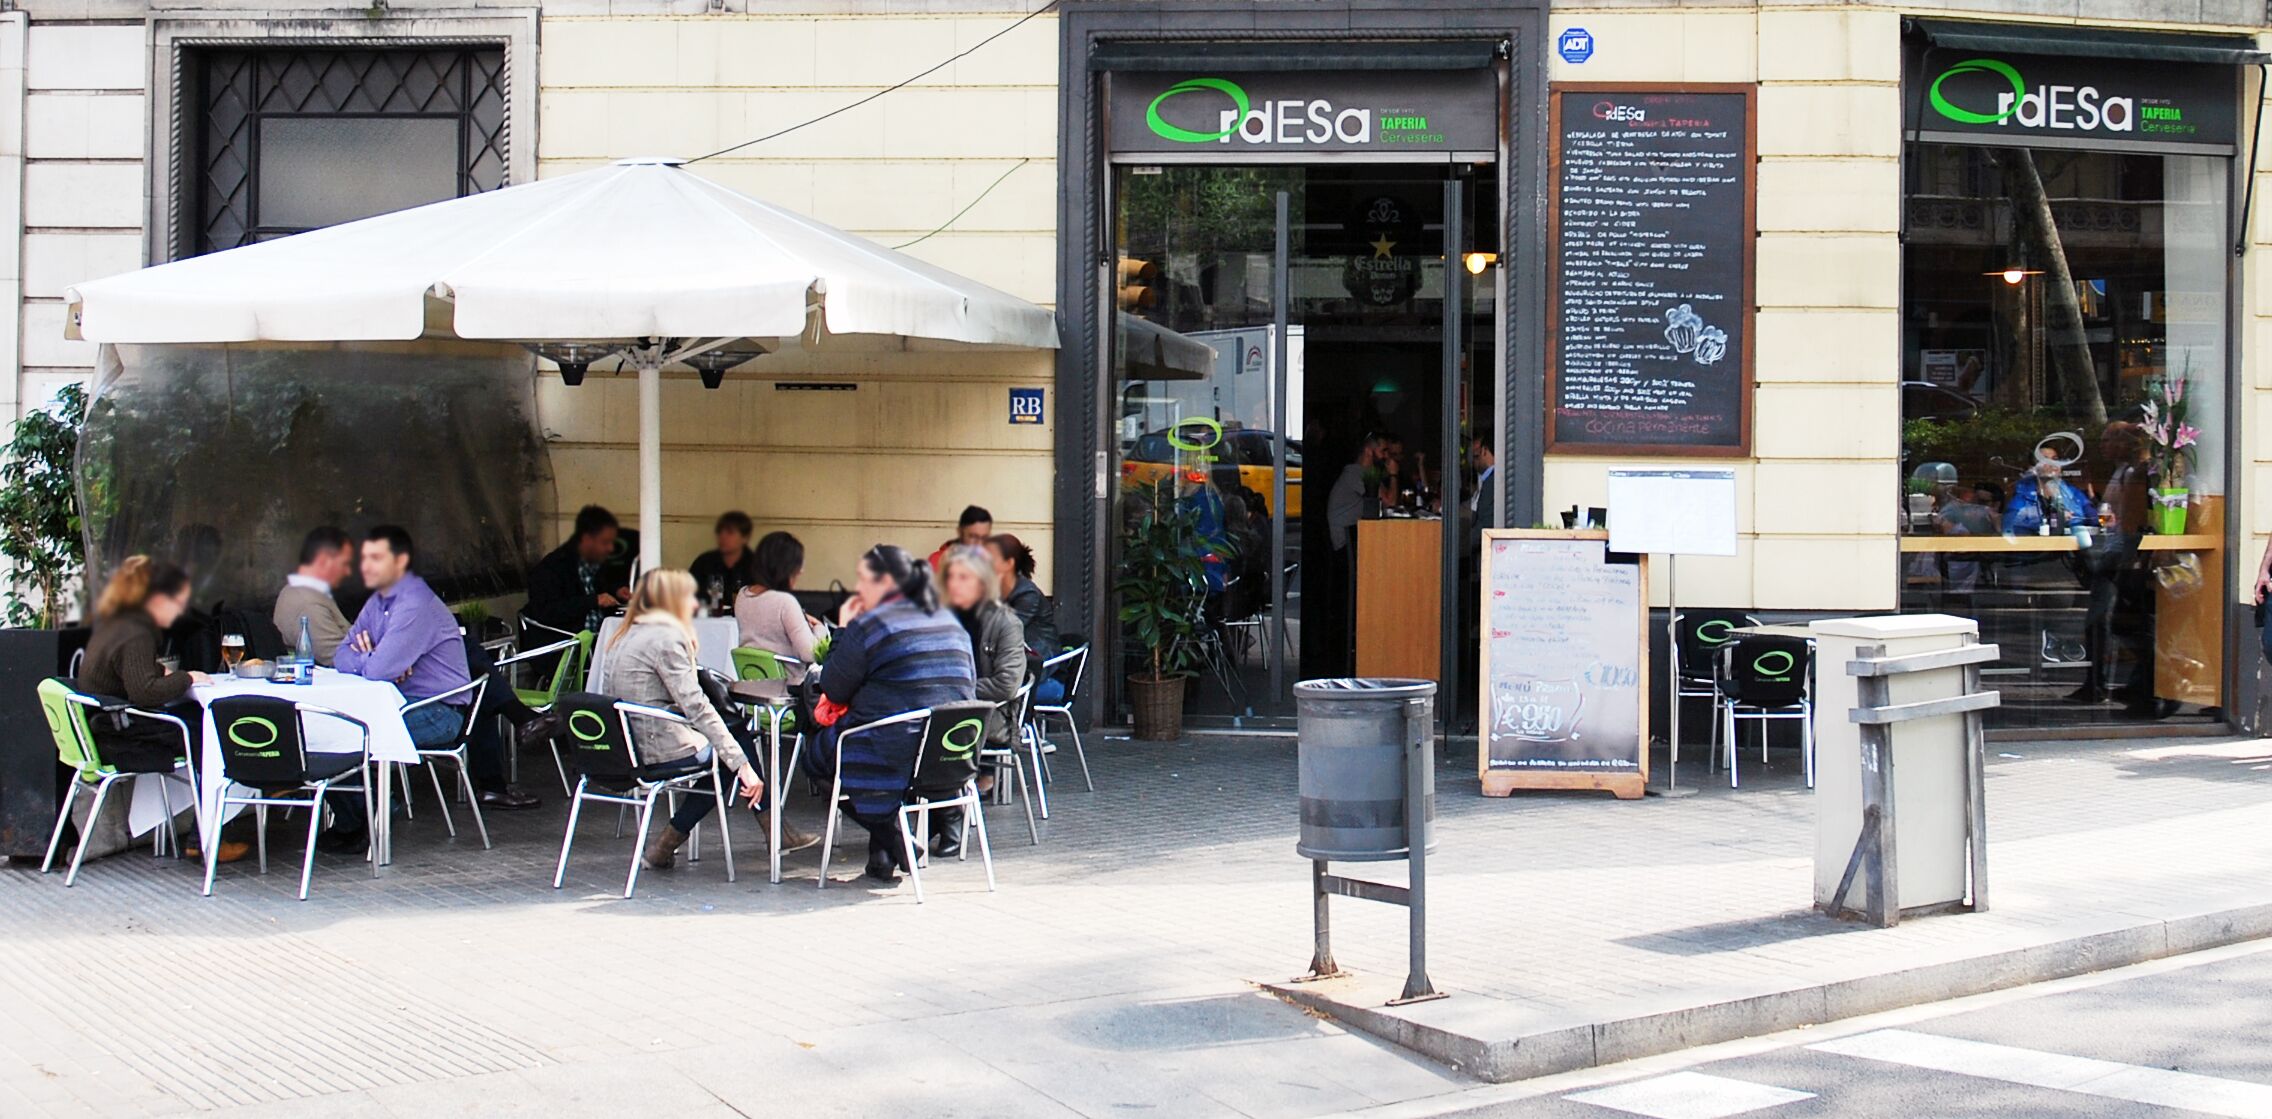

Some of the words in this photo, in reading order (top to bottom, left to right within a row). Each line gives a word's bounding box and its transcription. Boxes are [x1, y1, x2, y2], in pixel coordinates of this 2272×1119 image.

[1564, 38, 1588, 51] ADT
[2141, 107, 2182, 120] TAPERIA
[1380, 117, 1428, 129] TAPERIA
[1354, 255, 1412, 271] Estrella
[1012, 397, 1042, 415] RB
